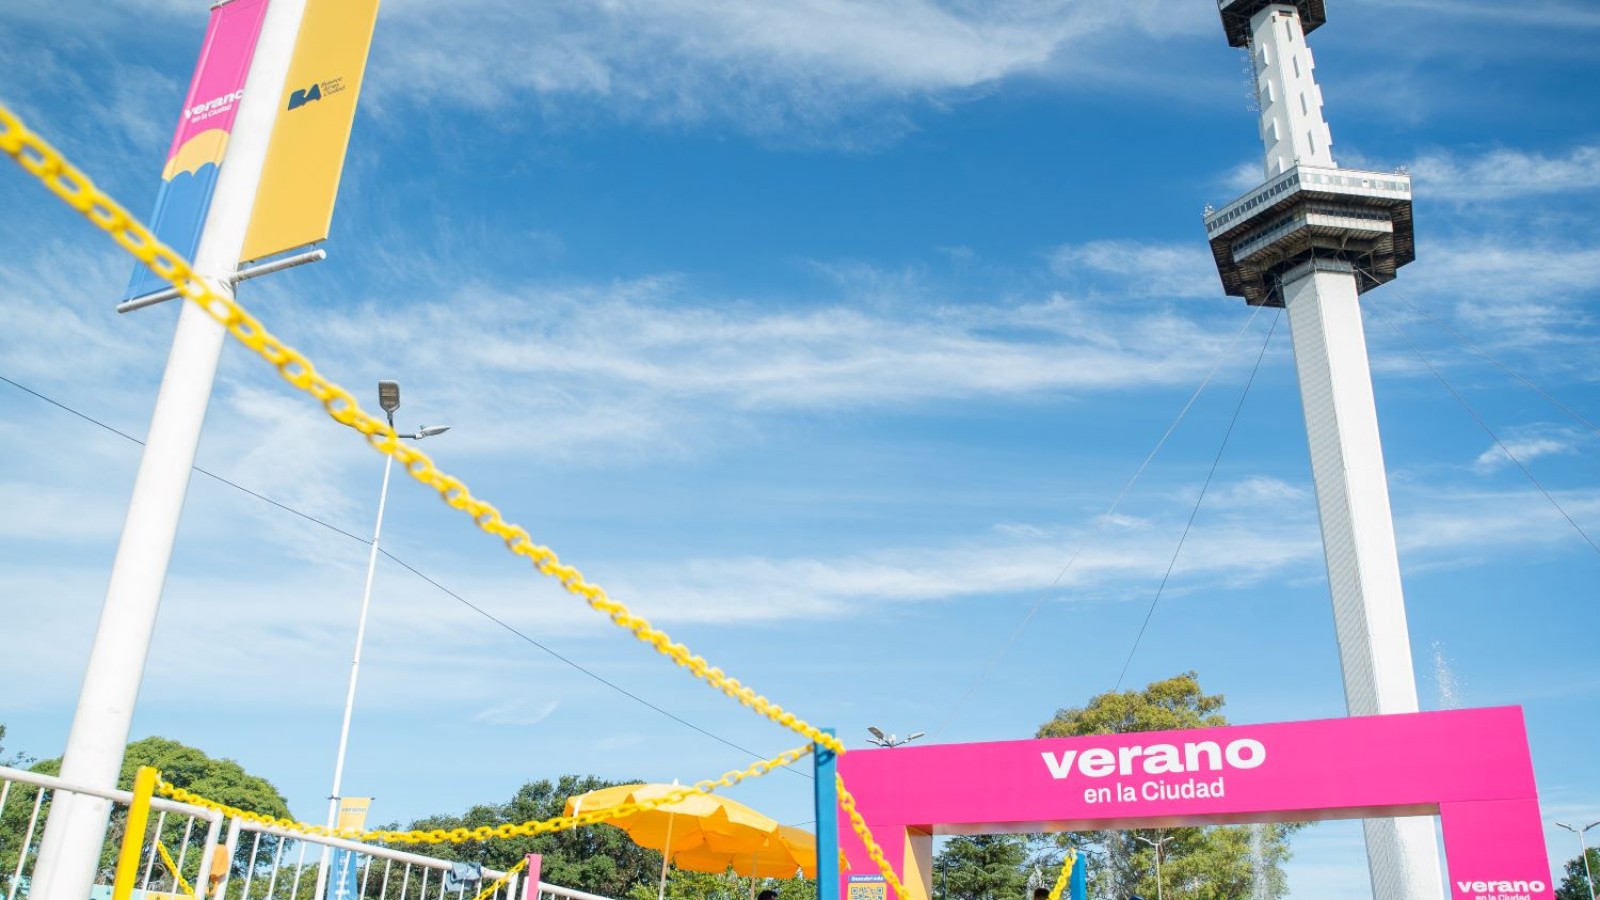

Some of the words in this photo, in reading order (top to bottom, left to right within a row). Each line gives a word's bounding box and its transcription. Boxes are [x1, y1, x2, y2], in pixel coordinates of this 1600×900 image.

[208, 102, 233, 118] Ciudad
[287, 83, 322, 111] BA
[1041, 738, 1266, 779] verano
[1084, 788, 1111, 804] en
[1117, 783, 1137, 803] la
[1141, 777, 1225, 802] Ciudad
[1456, 880, 1546, 893] verano
